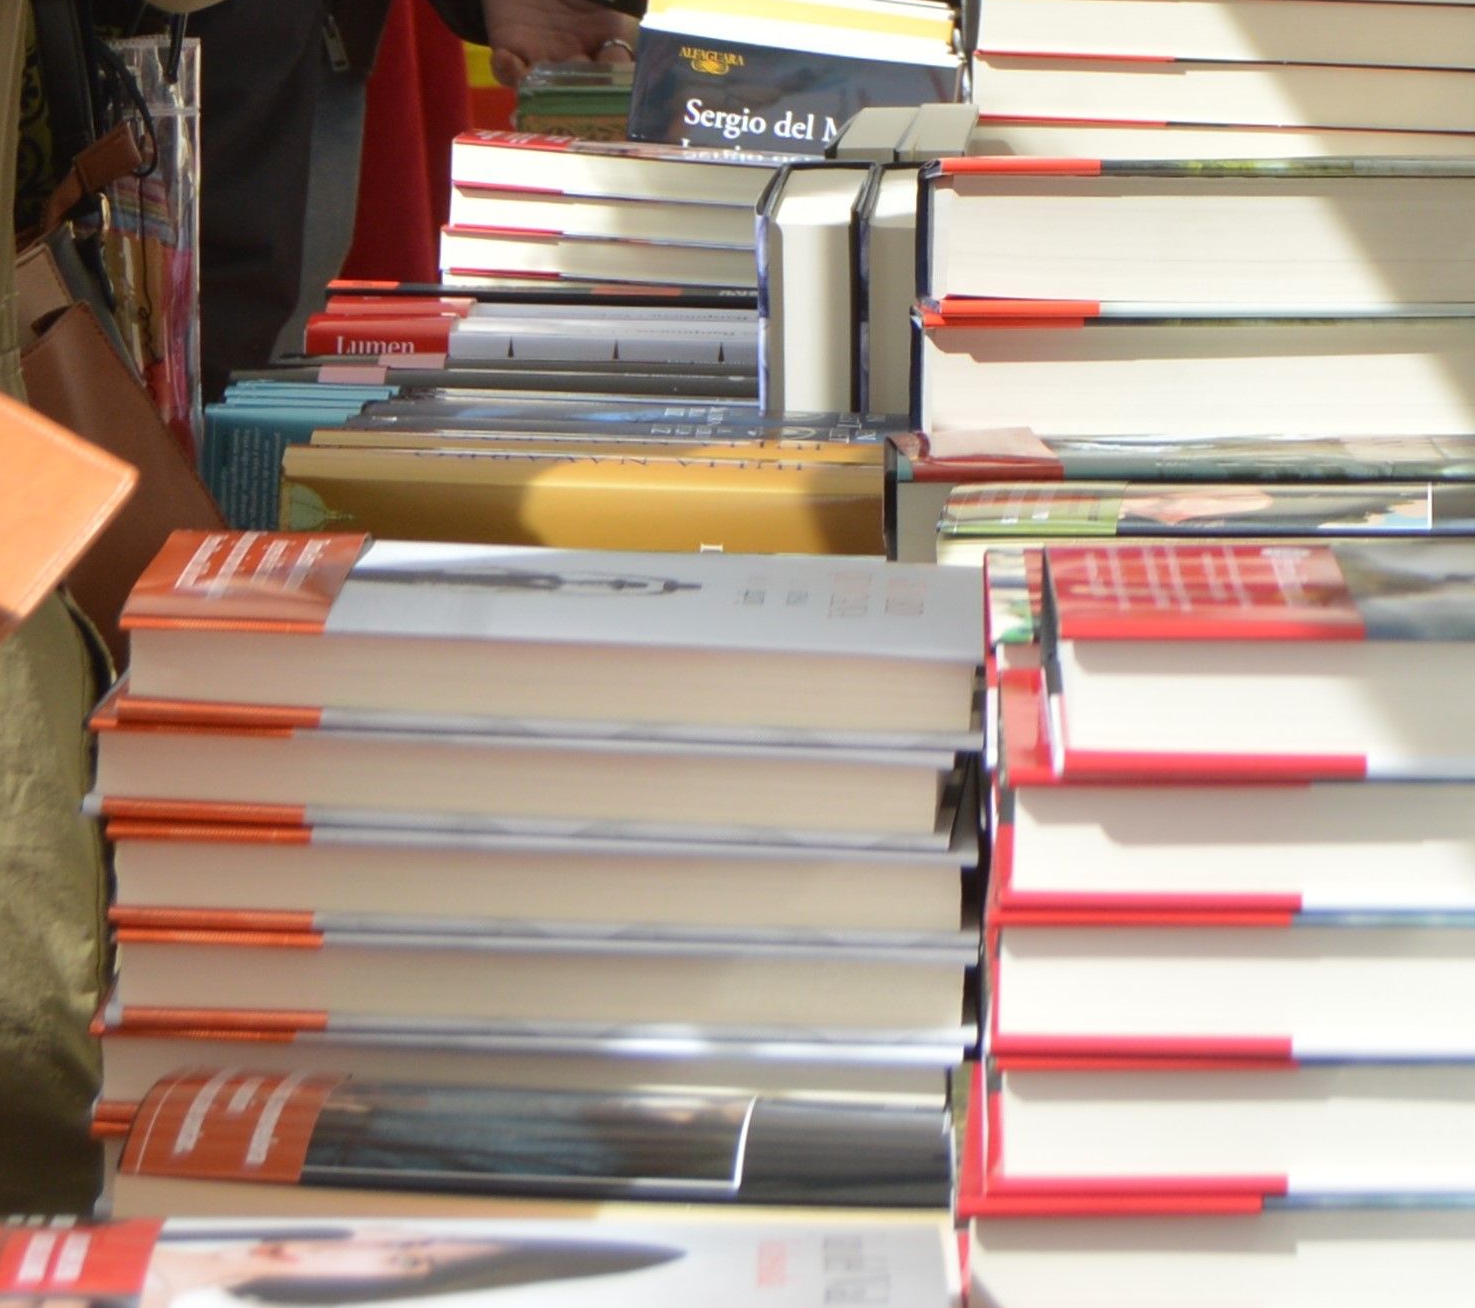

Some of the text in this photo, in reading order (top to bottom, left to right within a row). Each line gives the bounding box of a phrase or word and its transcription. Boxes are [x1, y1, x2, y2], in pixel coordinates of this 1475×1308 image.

[678, 45, 745, 67] ALFAGUARA
[683, 97, 767, 140] Sergio
[773, 110, 814, 141] del
[335, 334, 416, 355] Lumen
